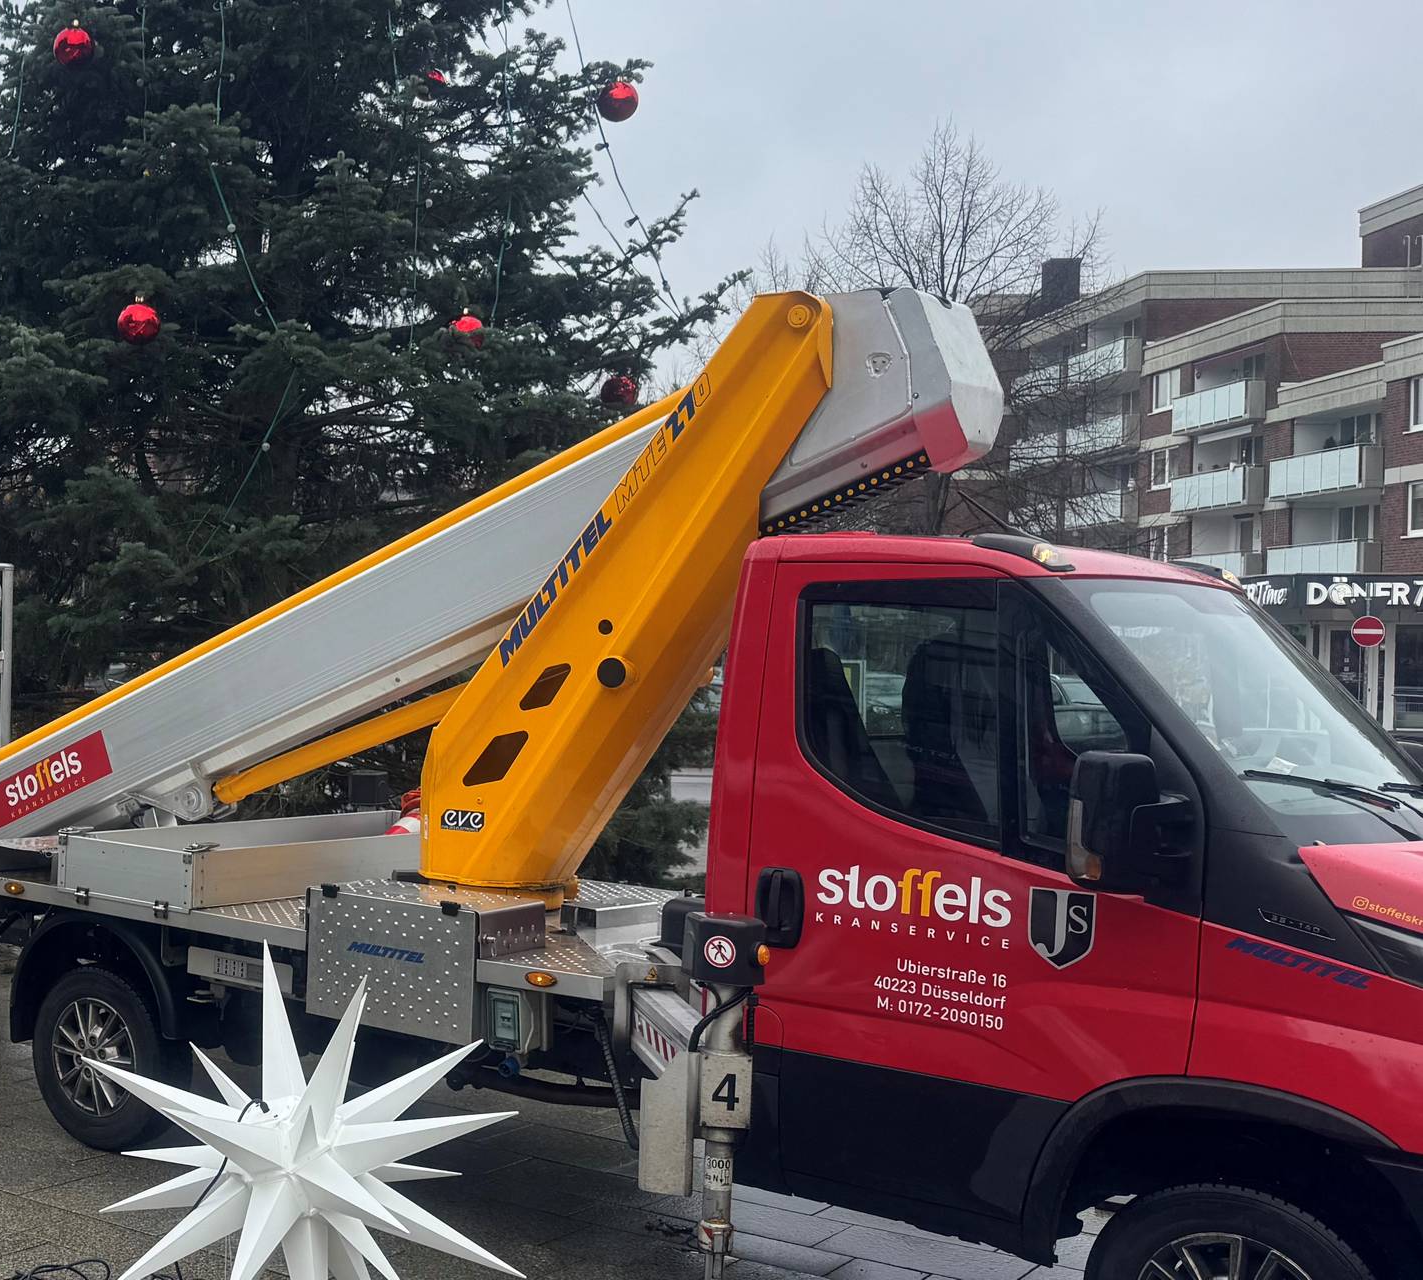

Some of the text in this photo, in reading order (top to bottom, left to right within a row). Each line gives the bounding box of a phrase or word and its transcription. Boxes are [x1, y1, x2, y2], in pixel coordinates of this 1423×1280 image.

[498, 510, 613, 668] MULTITEL
[1306, 576, 1410, 606] DÖNER
[5, 750, 82, 807] stoffels
[11, 776, 87, 819] KRANSERVICE
[444, 810, 483, 829] eve
[816, 864, 1012, 928] stoffels
[815, 912, 1010, 950] KRANSERVICE
[346, 941, 425, 964] MULTITEL
[1226, 937, 1372, 990] MULTITEL
[896, 957, 1007, 988] Ubierstraße 16
[873, 975, 1007, 1010] 40223 Düsseldorf
[876, 995, 1004, 1031] M: 0172-2090150
[711, 1073, 740, 1112] 4
[706, 1157, 731, 1170] 3000
